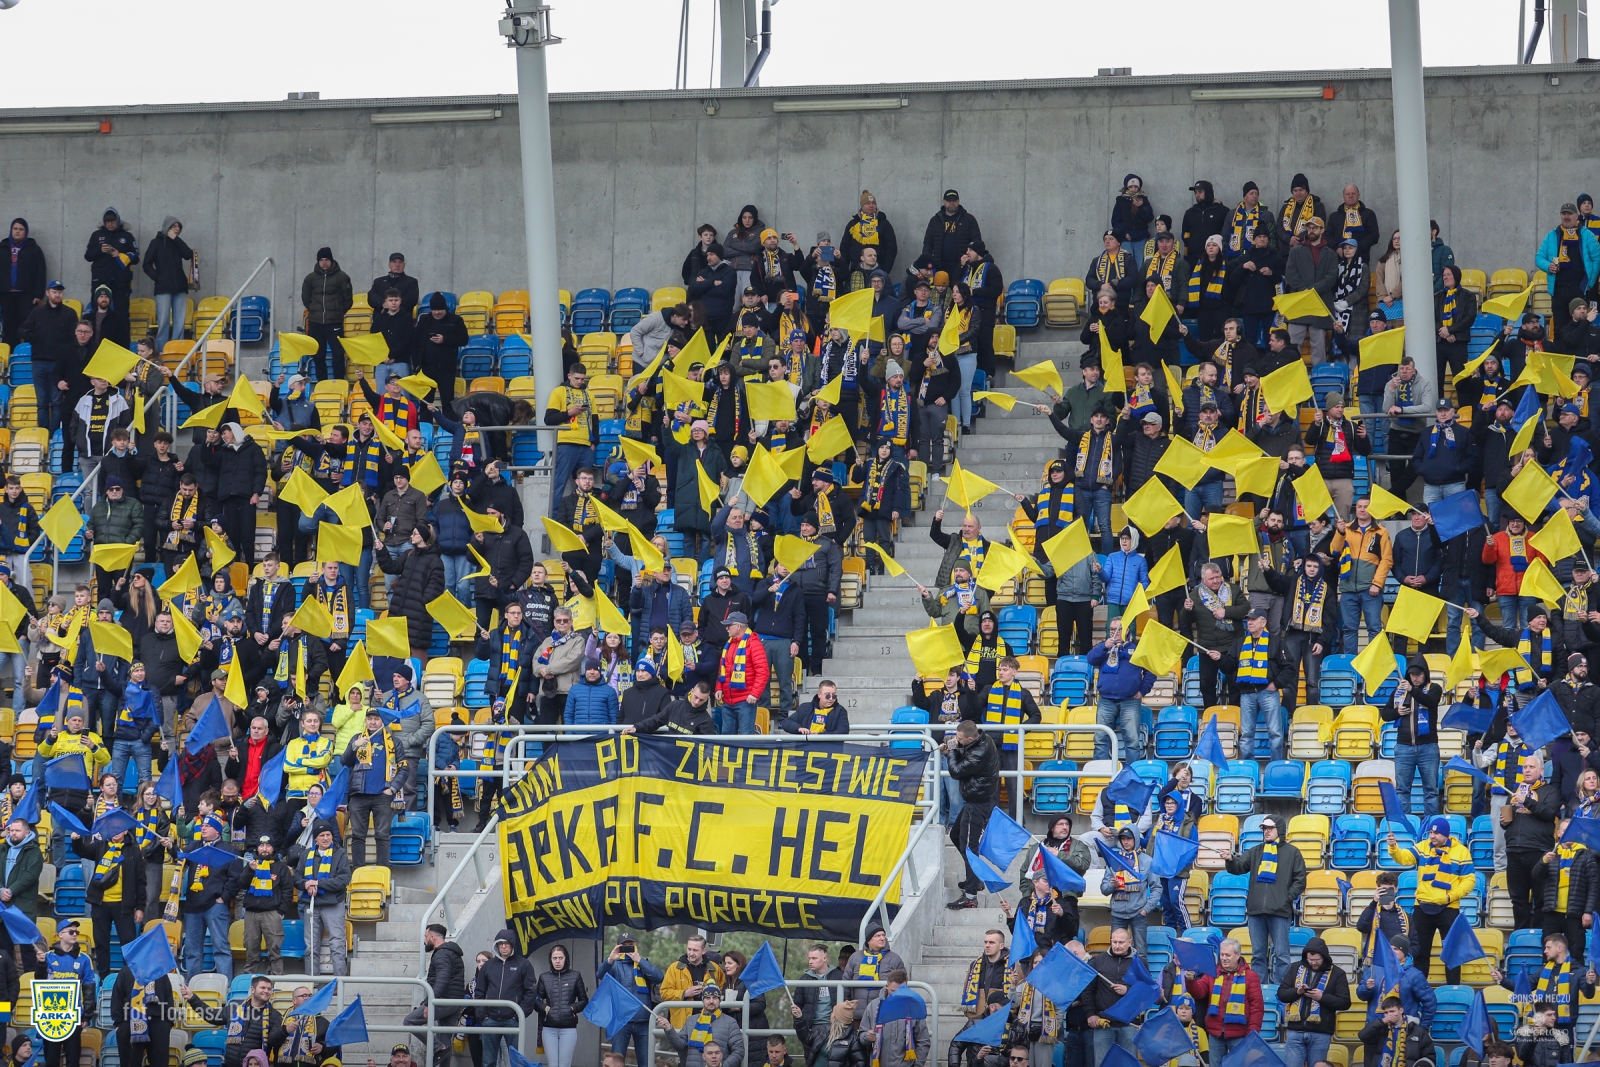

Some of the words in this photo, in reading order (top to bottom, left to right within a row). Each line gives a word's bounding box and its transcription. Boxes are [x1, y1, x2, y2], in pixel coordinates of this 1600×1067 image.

[1060, 361, 1071, 370] 19
[1002, 452, 1013, 461] 17
[881, 646, 891, 655] 13
[848, 698, 858, 708] 12
[490, 753, 563, 816] UMNI
[596, 735, 639, 779] PO
[676, 740, 908, 798] ZWYCIĘSTWIE
[508, 795, 618, 903] ARKA
[768, 807, 881, 887] HEL
[488, 852, 495, 862] 9
[605, 881, 644, 919] PO
[665, 886, 823, 930] PORAŻCE
[439, 909, 445, 919] 8
[997, 913, 1004, 923] 8
[402, 964, 408, 973] 7
